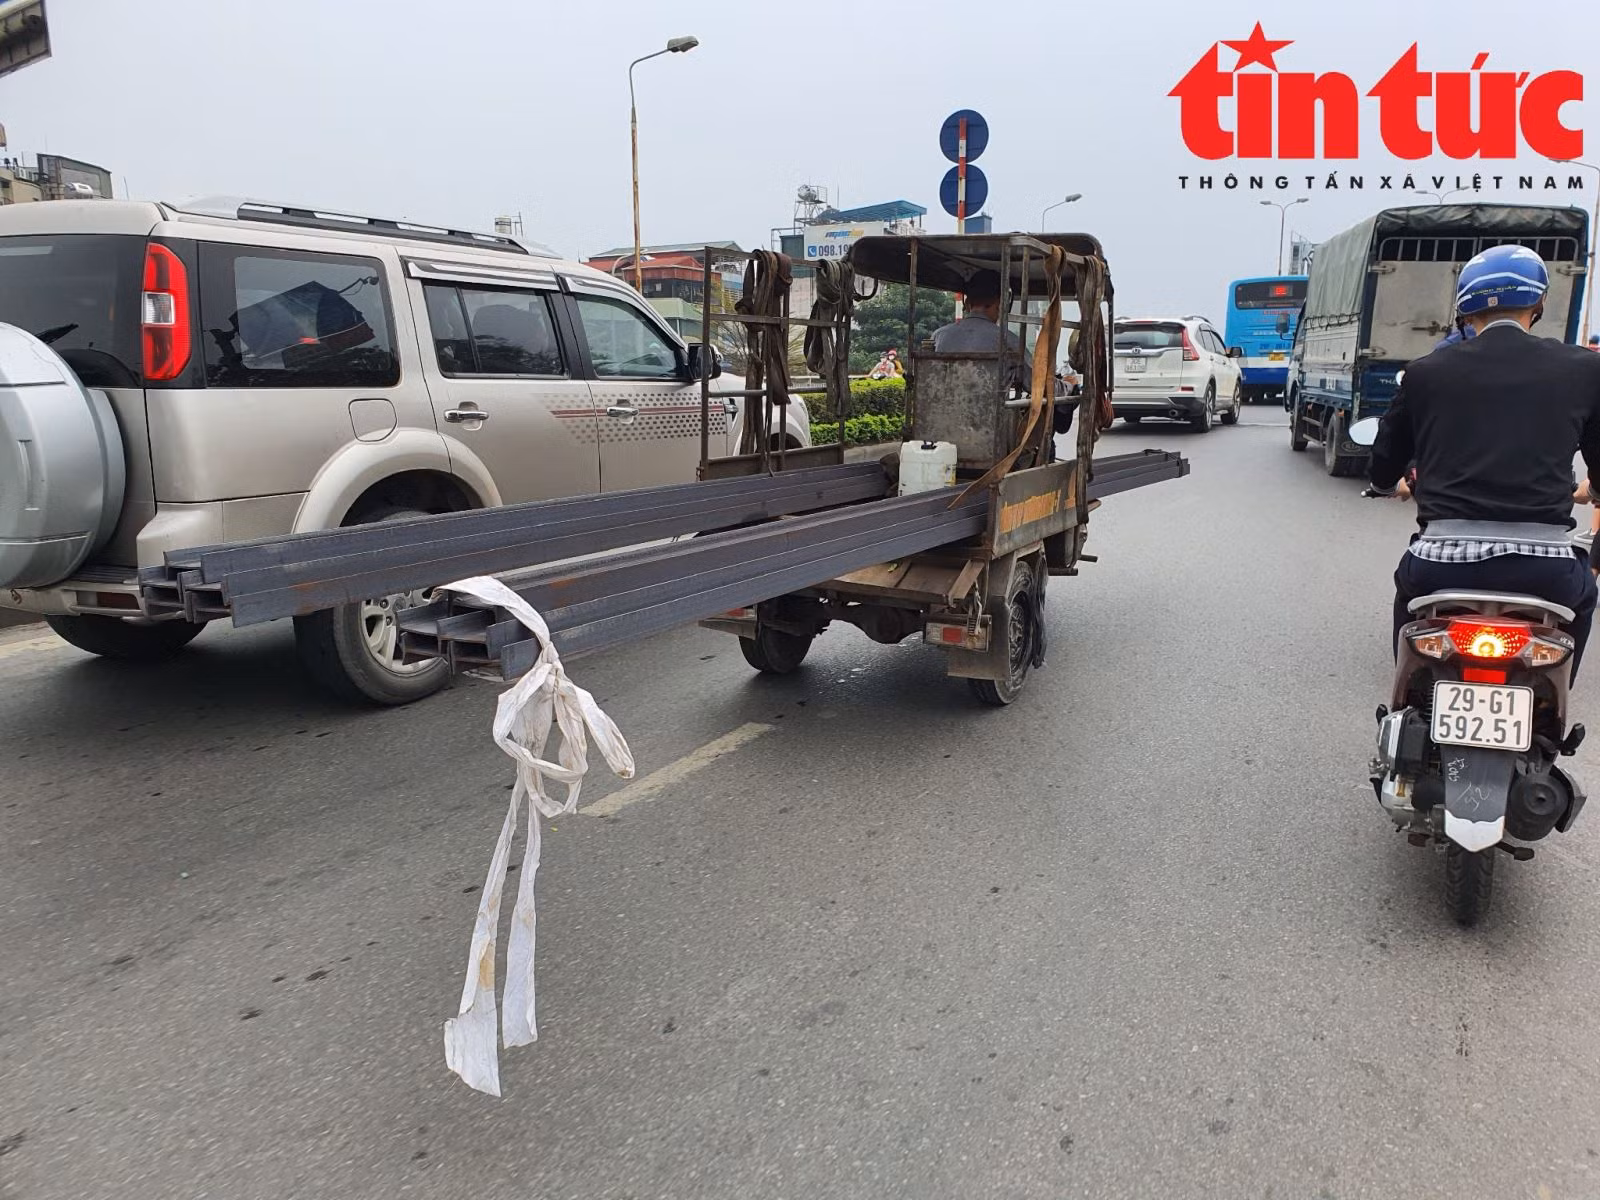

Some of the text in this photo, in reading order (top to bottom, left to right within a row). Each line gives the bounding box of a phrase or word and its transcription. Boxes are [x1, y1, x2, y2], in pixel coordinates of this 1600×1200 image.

[818, 244, 852, 257] 098.19
[1448, 686, 1515, 716] 29-G1
[1439, 713, 1522, 746] 592.51
